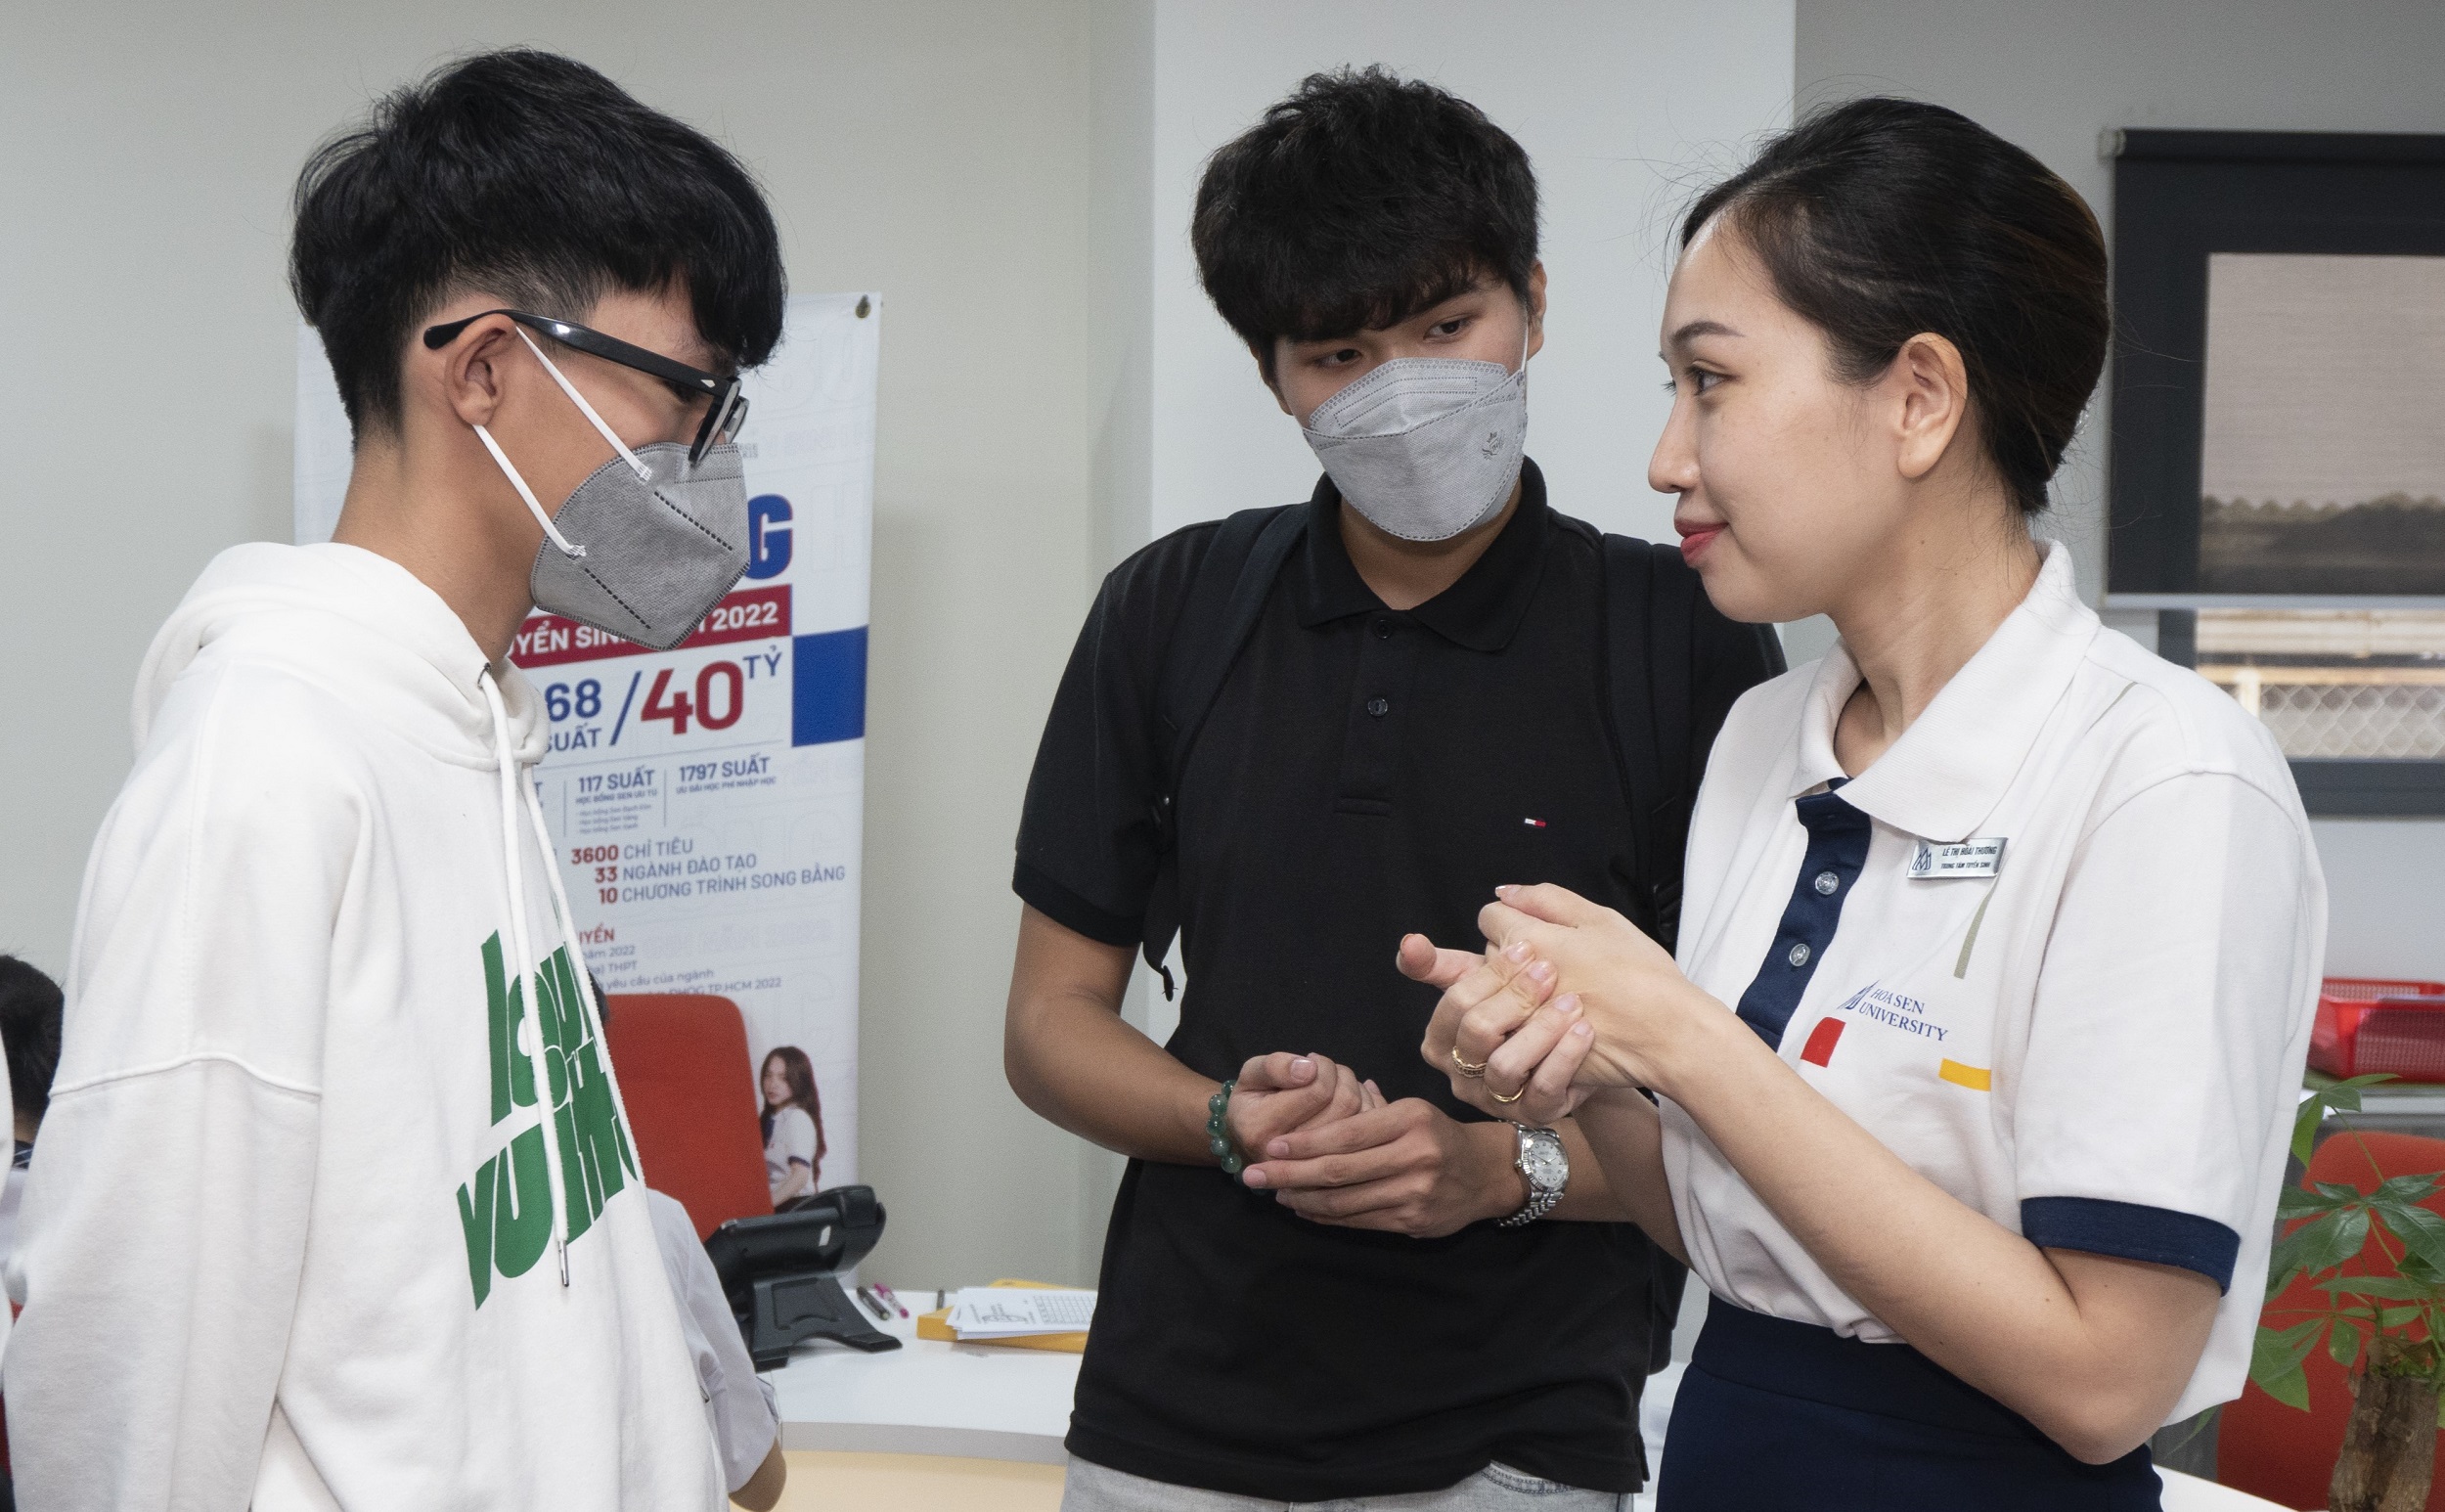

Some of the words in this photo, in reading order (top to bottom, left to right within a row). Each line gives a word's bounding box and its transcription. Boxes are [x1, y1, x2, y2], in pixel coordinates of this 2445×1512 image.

[744, 494, 793, 580] G
[711, 600, 778, 632] 2022
[506, 619, 569, 656] YỂN
[575, 626, 627, 648] SIN
[545, 678, 601, 722] 68
[742, 645, 782, 681] TỶ
[579, 775, 602, 793] 117
[607, 765, 655, 790] SUẤT
[680, 763, 718, 782] 1797
[722, 752, 771, 778] SUẤT
[571, 845, 619, 865] 3600
[656, 836, 693, 858] TIÊU
[595, 866, 618, 884] 33
[623, 861, 682, 881] NGÀNH
[687, 854, 721, 874] ĐÀO
[726, 853, 757, 872] TẠO
[599, 887, 618, 905] 10
[622, 881, 691, 903] CHƯƠNG
[696, 874, 747, 895] TRÌNH
[751, 869, 796, 890] SONG
[609, 945, 636, 957] 2022
[755, 977, 781, 990] 2022
[1870, 988, 1894, 1004] HOA
[1893, 994, 1926, 1015] SEN
[1858, 1001, 1949, 1042] UNIVERSITY
